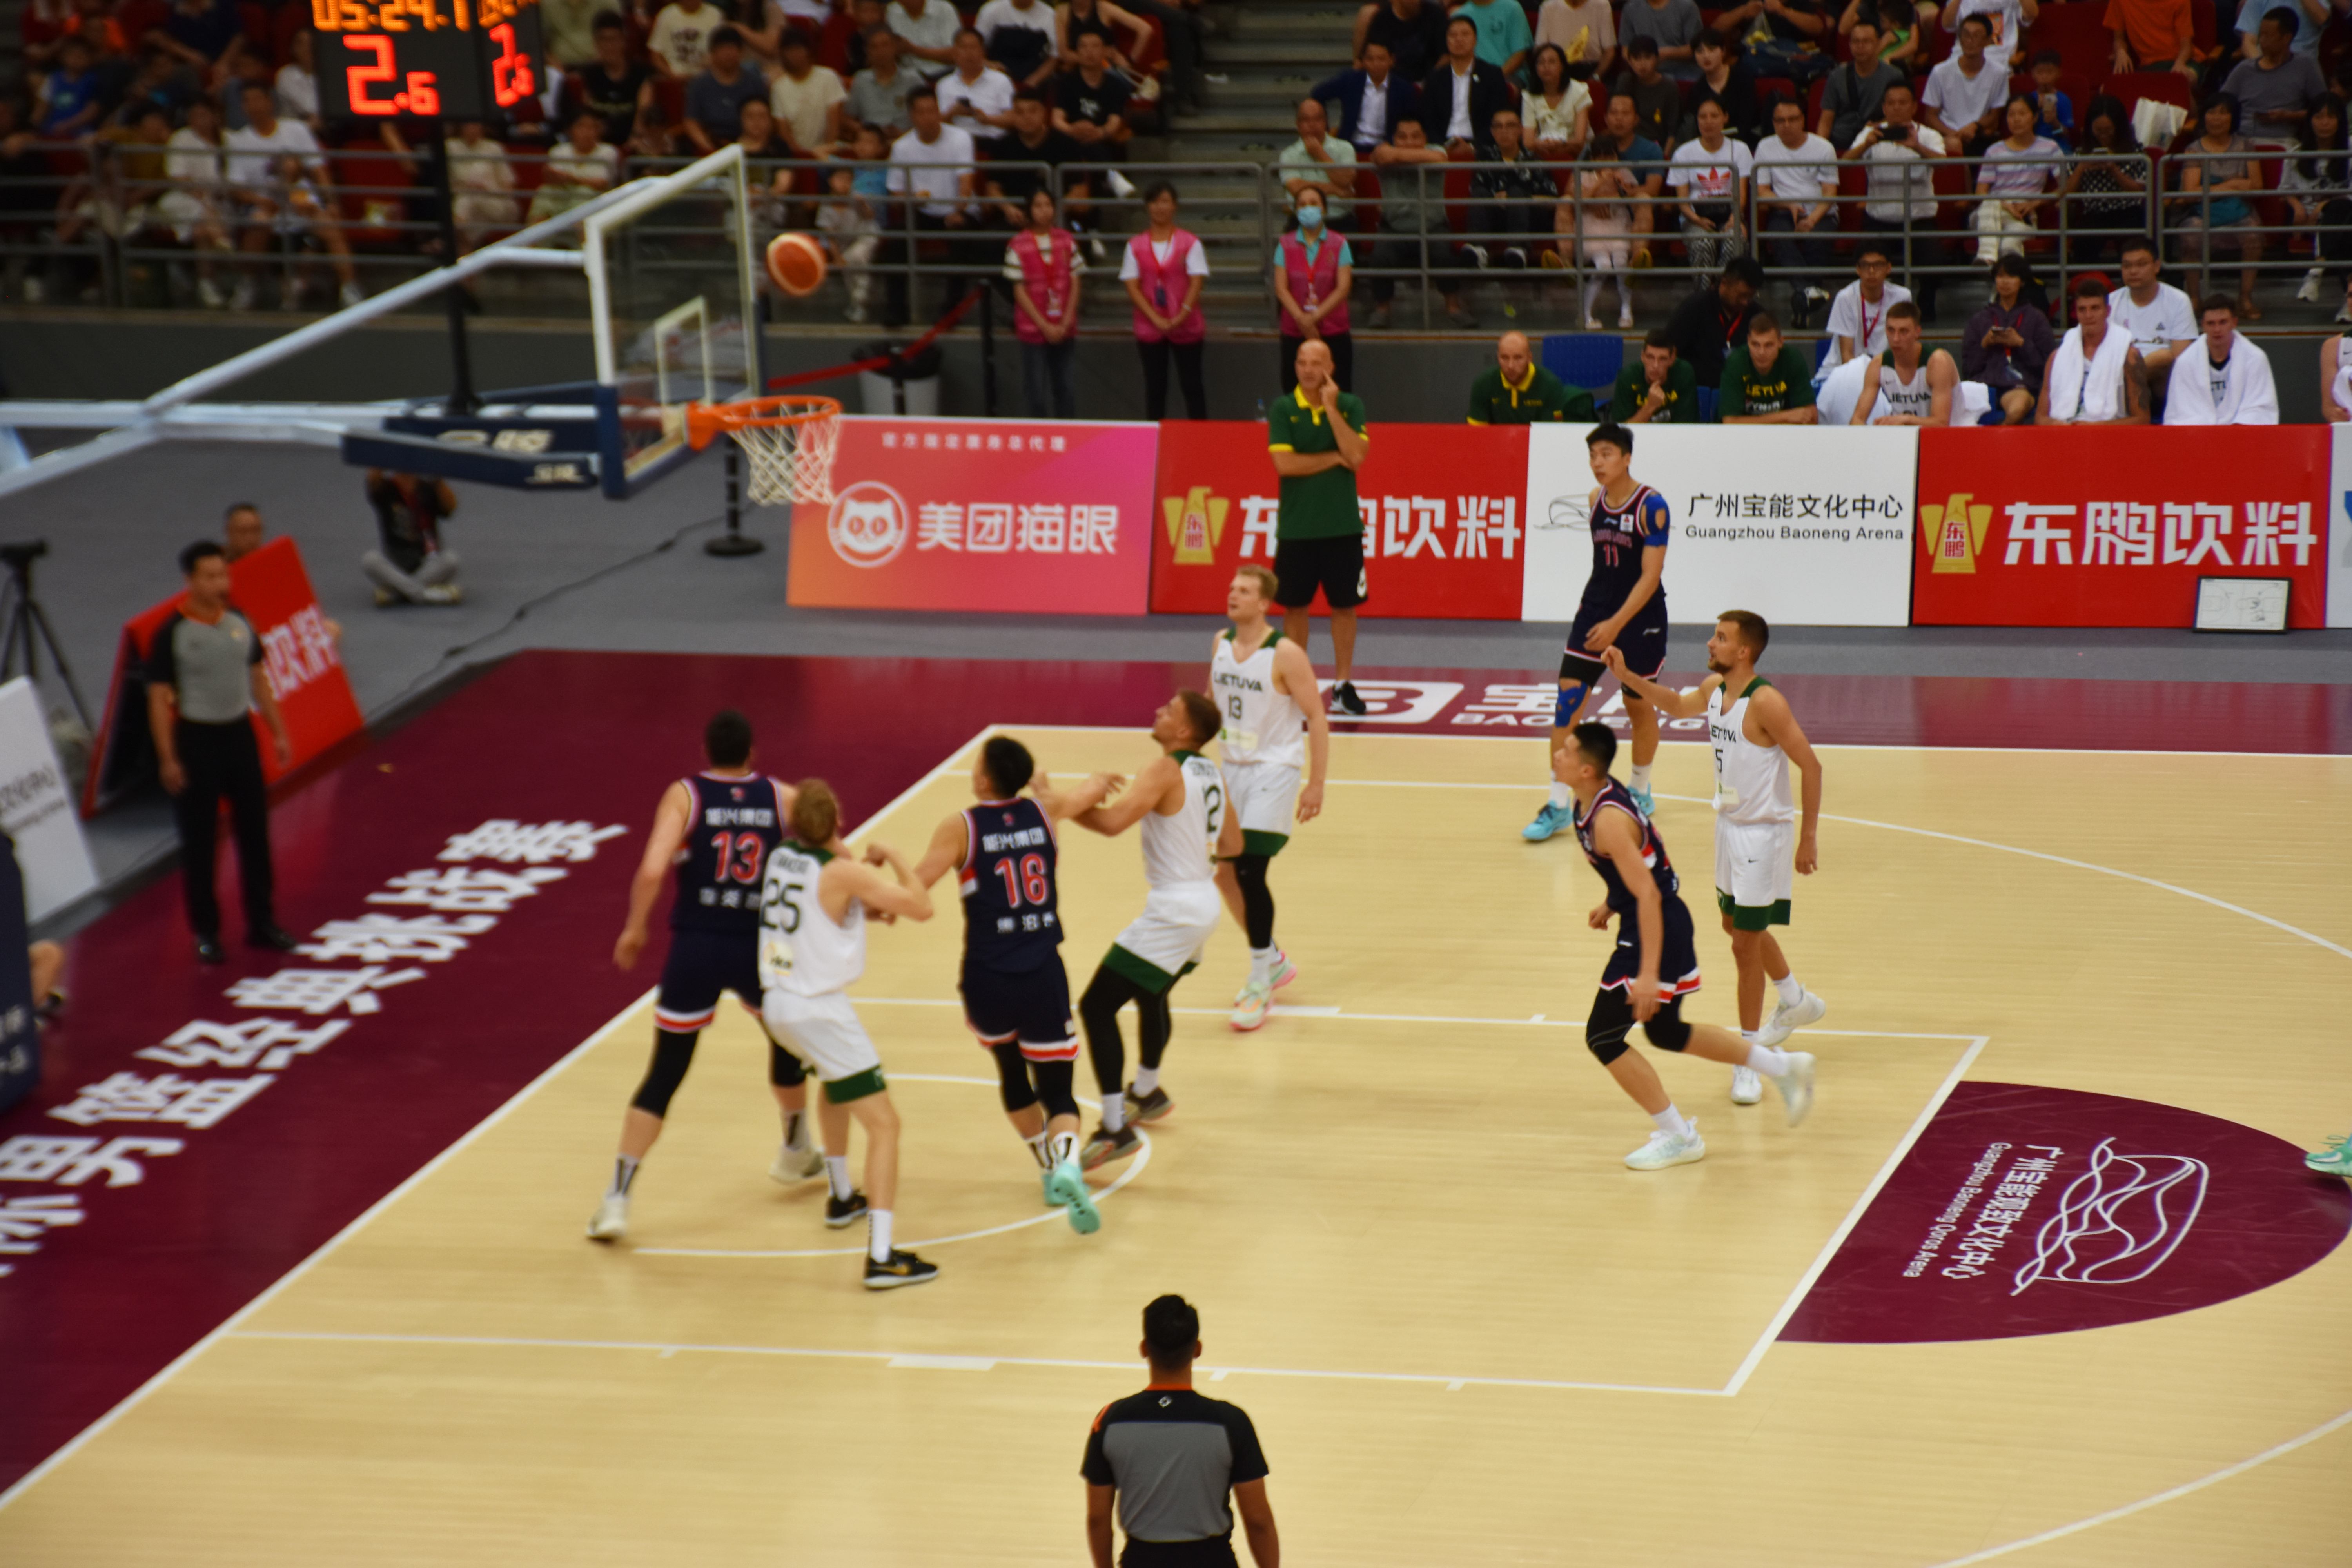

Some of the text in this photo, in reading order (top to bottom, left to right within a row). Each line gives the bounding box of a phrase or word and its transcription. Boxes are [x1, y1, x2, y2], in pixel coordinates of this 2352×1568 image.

[343, 34, 440, 115] 2.6
[915, 501, 1119, 554] 美团猫眼
[1686, 525, 1904, 542] Guangzhou Baoneng Arena
[1688, 493, 1904, 520] 广州宝能文化中心
[2004, 501, 2318, 566] 东鹏饮料
[1603, 543, 1619, 567] 11
[1229, 695, 1242, 719] 13
[1715, 748, 1724, 773] 5
[711, 830, 765, 885] 13
[994, 852, 1049, 909] 16
[760, 878, 804, 933] 25
[1902, 1142, 2012, 1277] Guangzhou Baoneng Qoros Arena
[1941, 1144, 2065, 1279] 广州宝能观致文化中心
